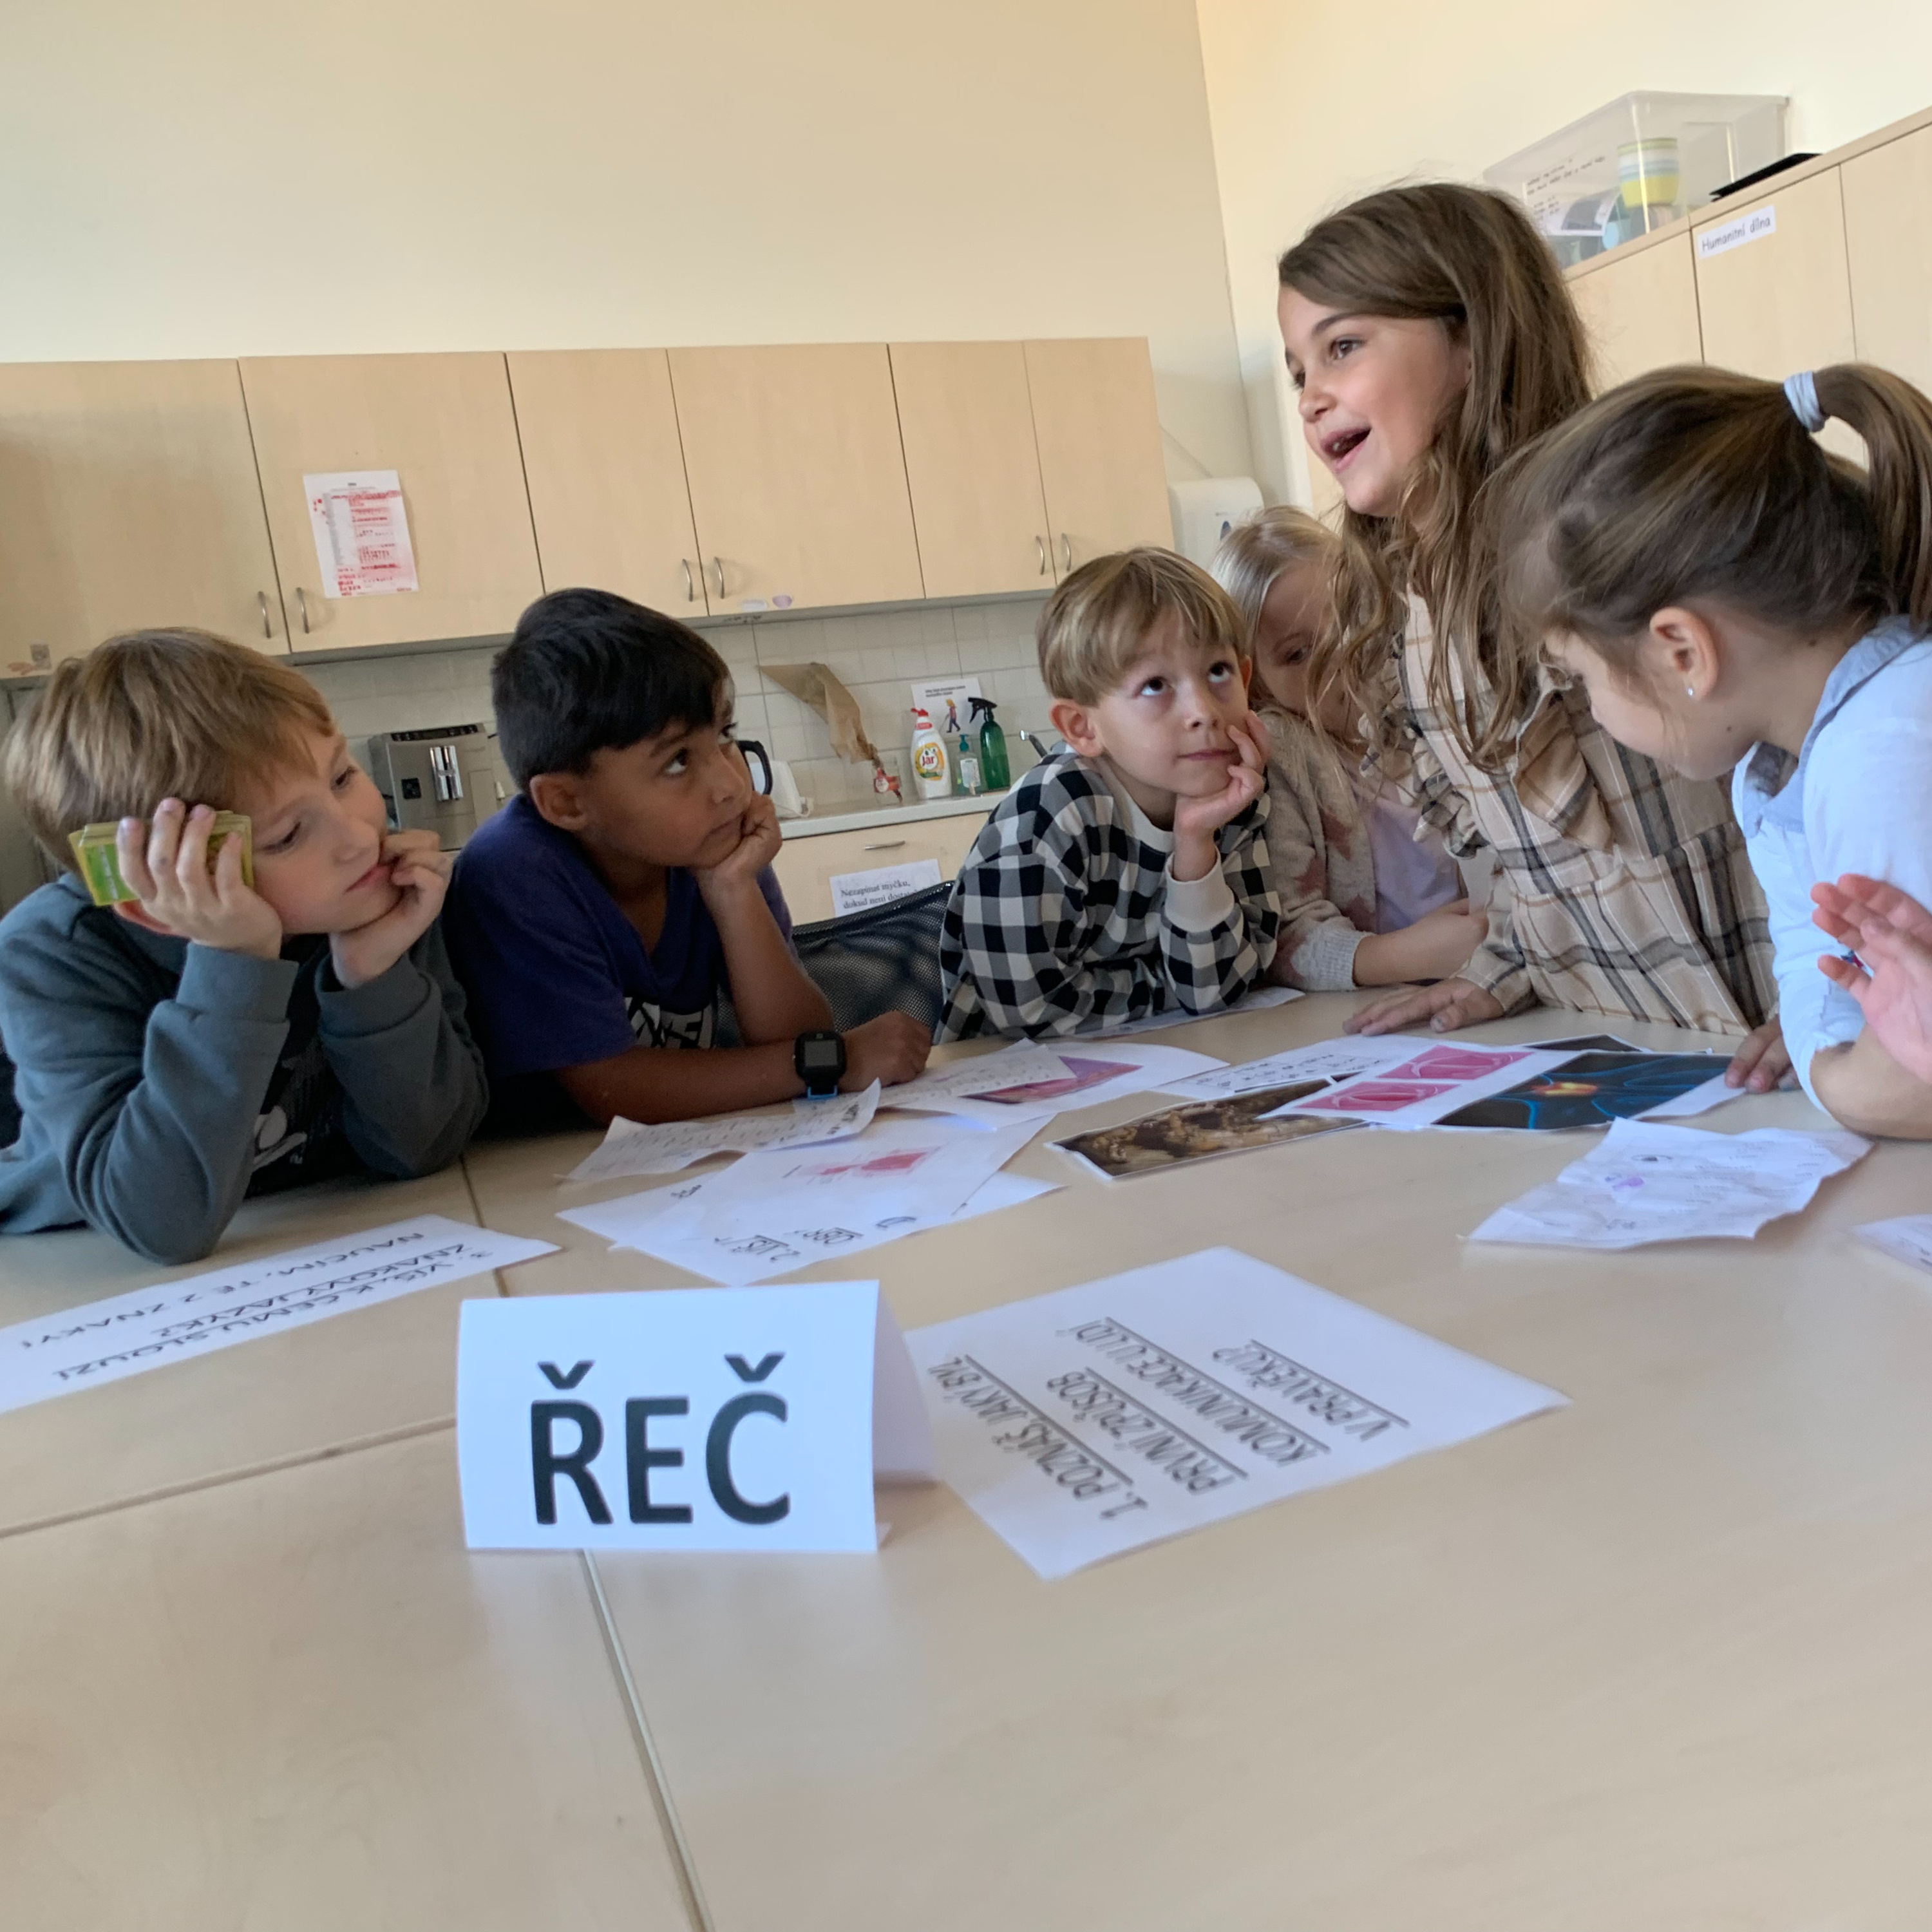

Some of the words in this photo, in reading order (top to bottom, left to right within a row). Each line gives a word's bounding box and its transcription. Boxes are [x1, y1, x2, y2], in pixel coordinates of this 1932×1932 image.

[1701, 222, 1746, 252] Humanitní
[922, 755, 935, 766] Jar
[531, 1352, 790, 1524] ŘEČ
[1126, 1355, 1318, 1466] KOMUNIKACE
